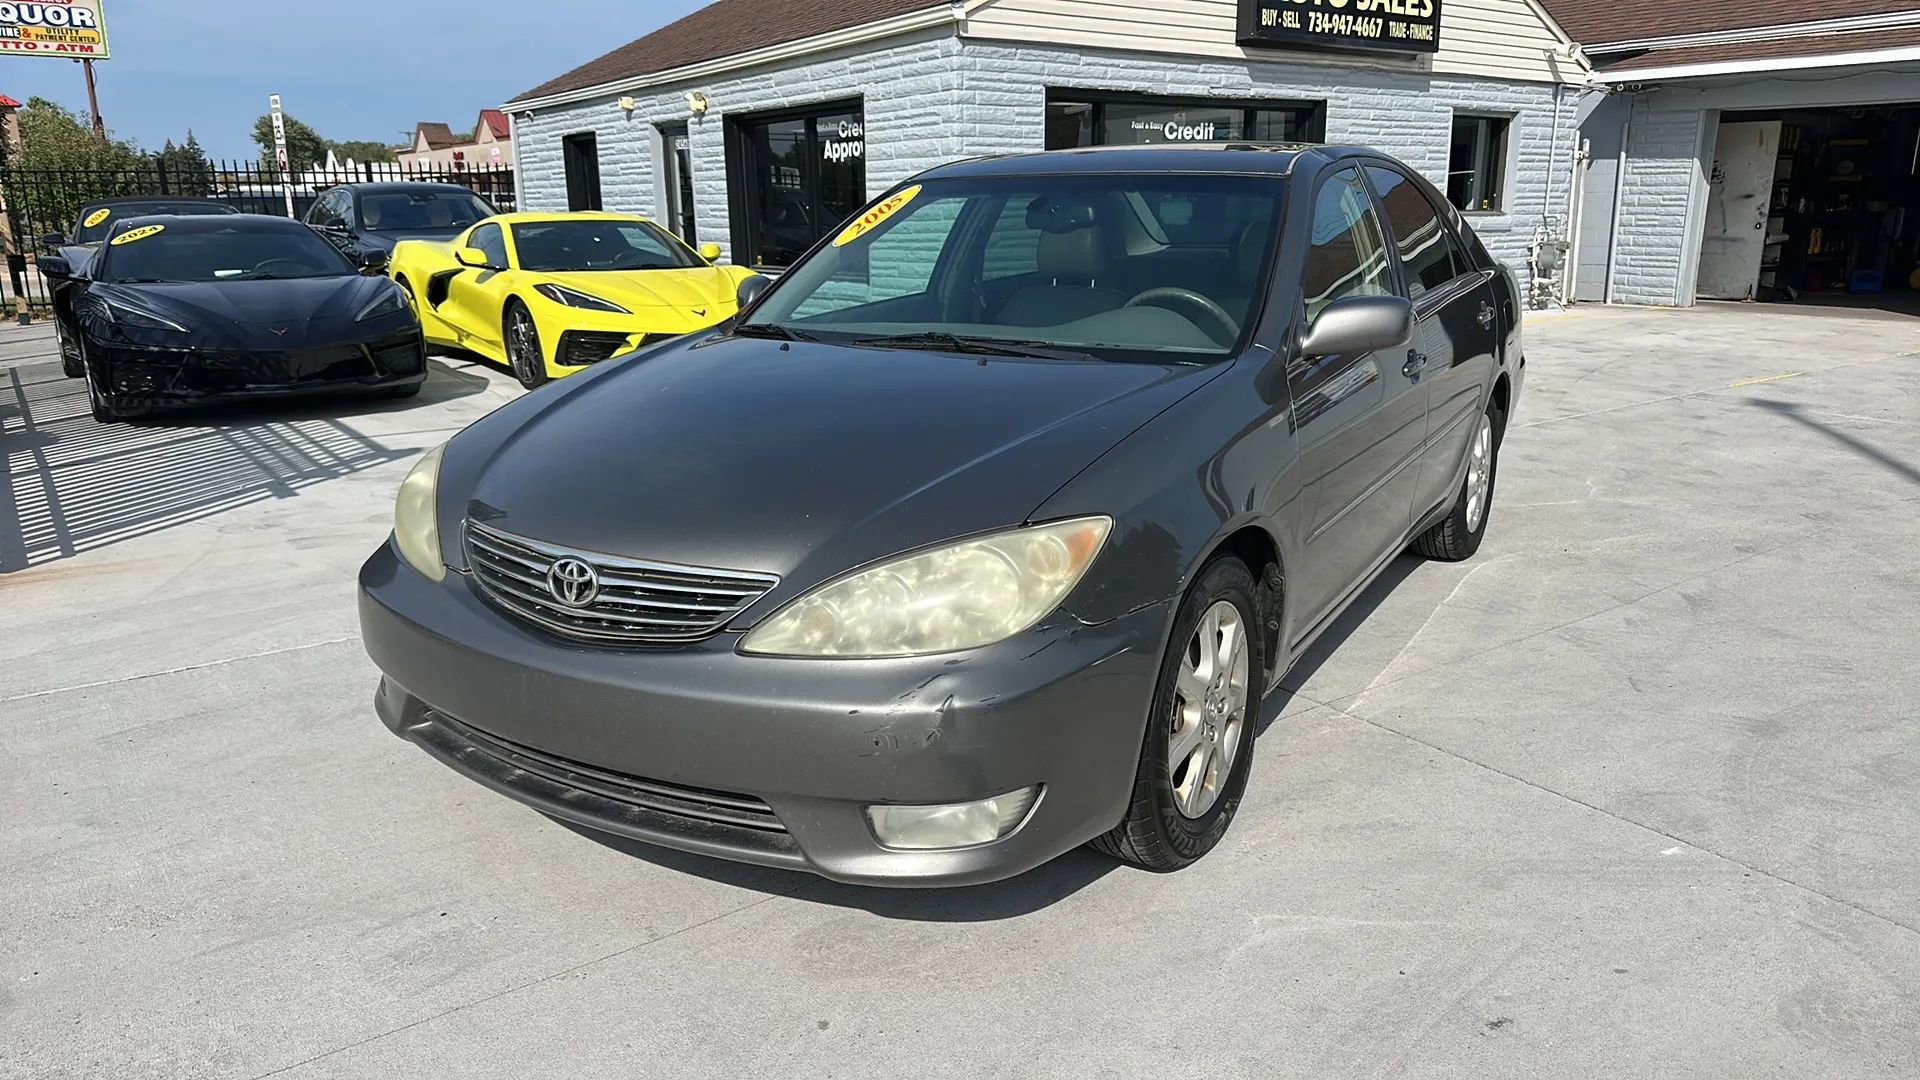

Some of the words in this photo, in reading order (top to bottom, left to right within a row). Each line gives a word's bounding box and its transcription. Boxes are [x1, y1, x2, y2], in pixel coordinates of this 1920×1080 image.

[1261, 8, 1278, 27] BUY
[1282, 10, 1301, 29] SELL
[1308, 11, 1383, 38] 734-947-4667
[1389, 21, 1407, 38] TRADE
[1409, 23, 1434, 41] FINANCE
[0, 27, 19, 37] INE
[22, 27, 31, 38] &
[35, 34, 67, 42] PAYMENT
[45, 28, 80, 36] UTILITY
[56, 44, 94, 52] ATM
[1164, 121, 1215, 140] Credit
[849, 194, 903, 236] 2005
[119, 226, 158, 242] 2024
